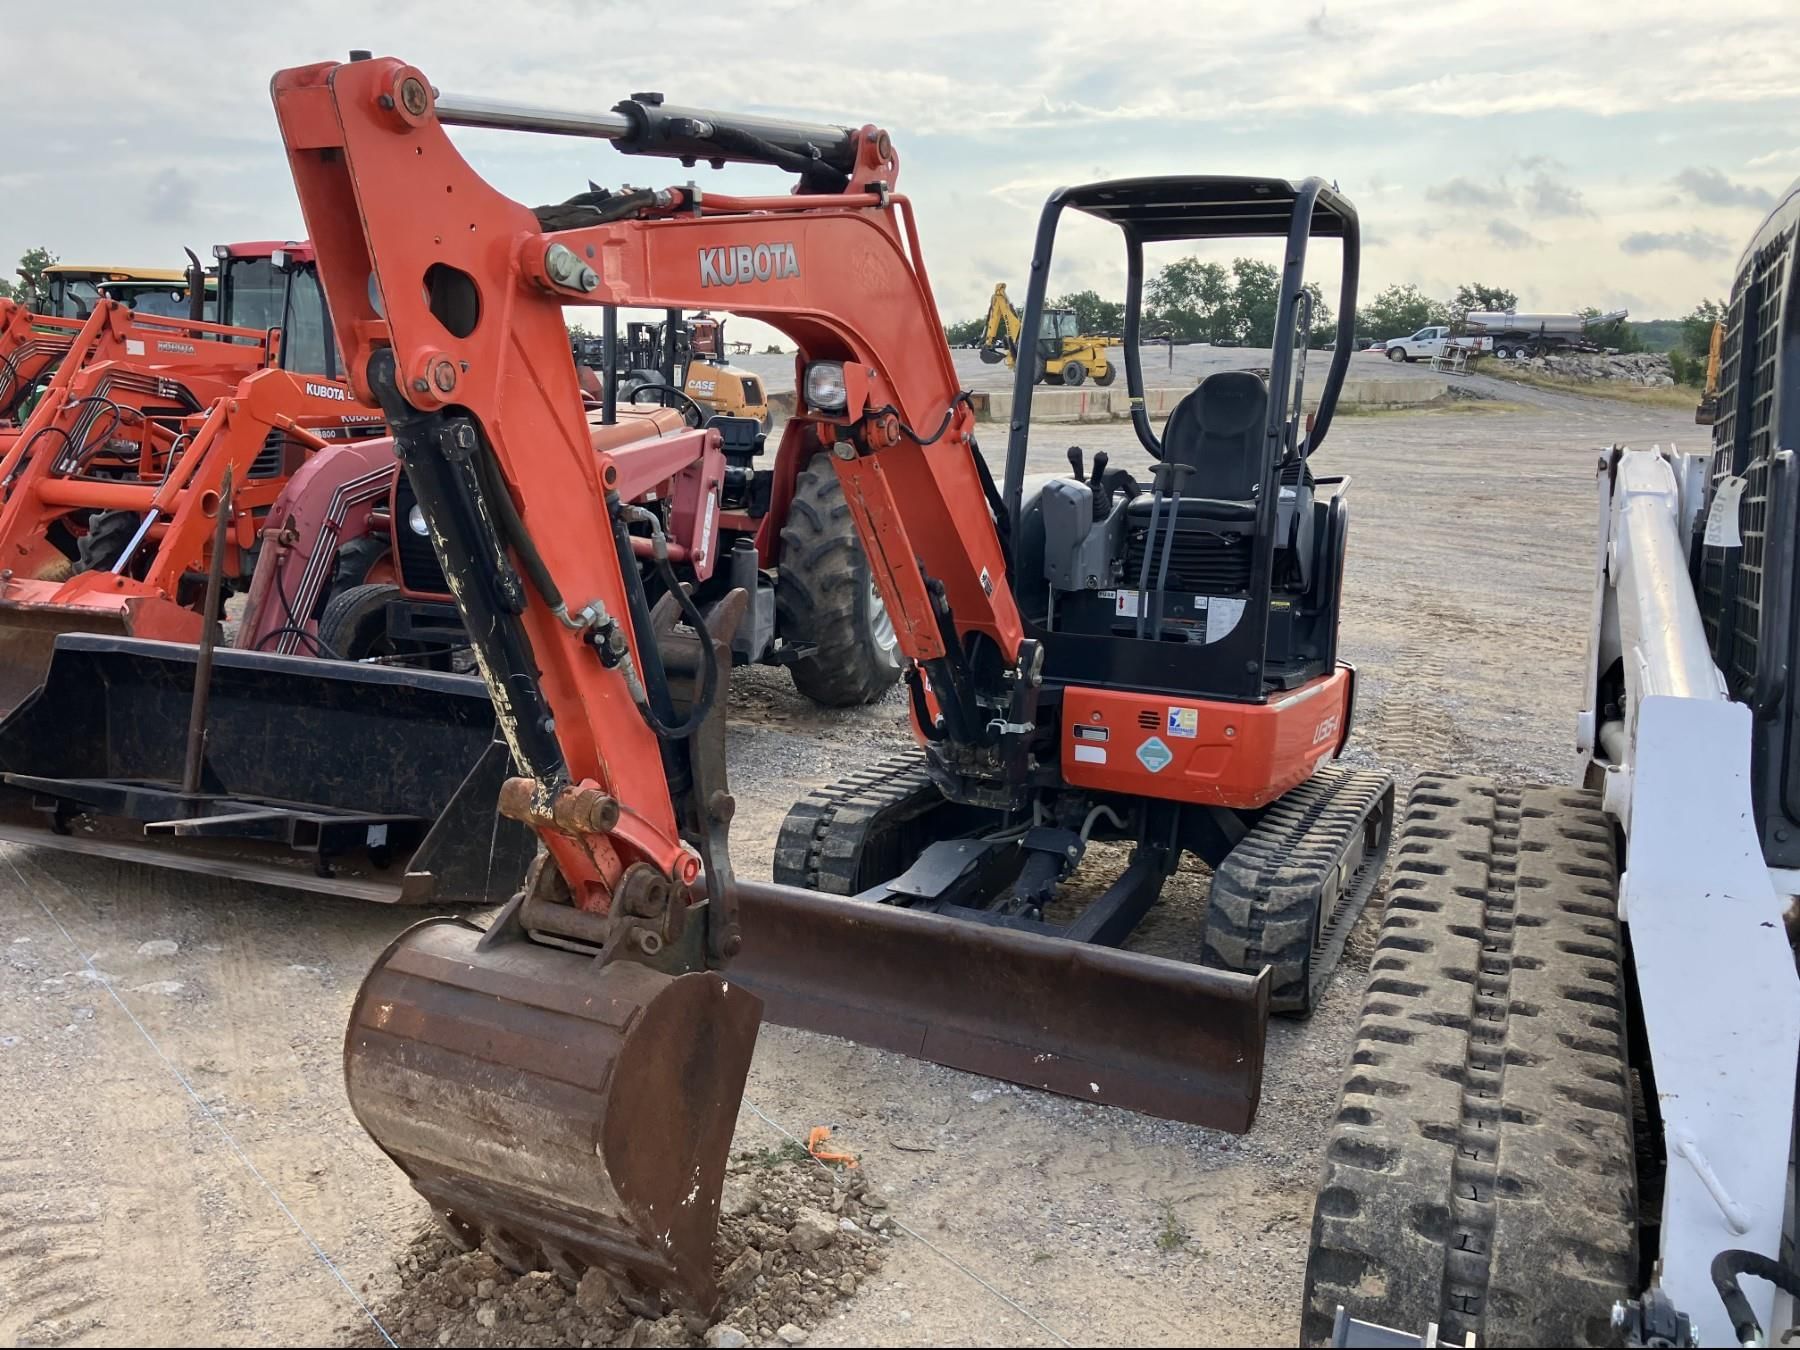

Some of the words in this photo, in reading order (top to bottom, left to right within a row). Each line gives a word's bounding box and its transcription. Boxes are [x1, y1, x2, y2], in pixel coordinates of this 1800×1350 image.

[698, 242, 801, 288] KUBOTA
[306, 383, 345, 400] KUBOTA
[688, 380, 716, 391] CASE
